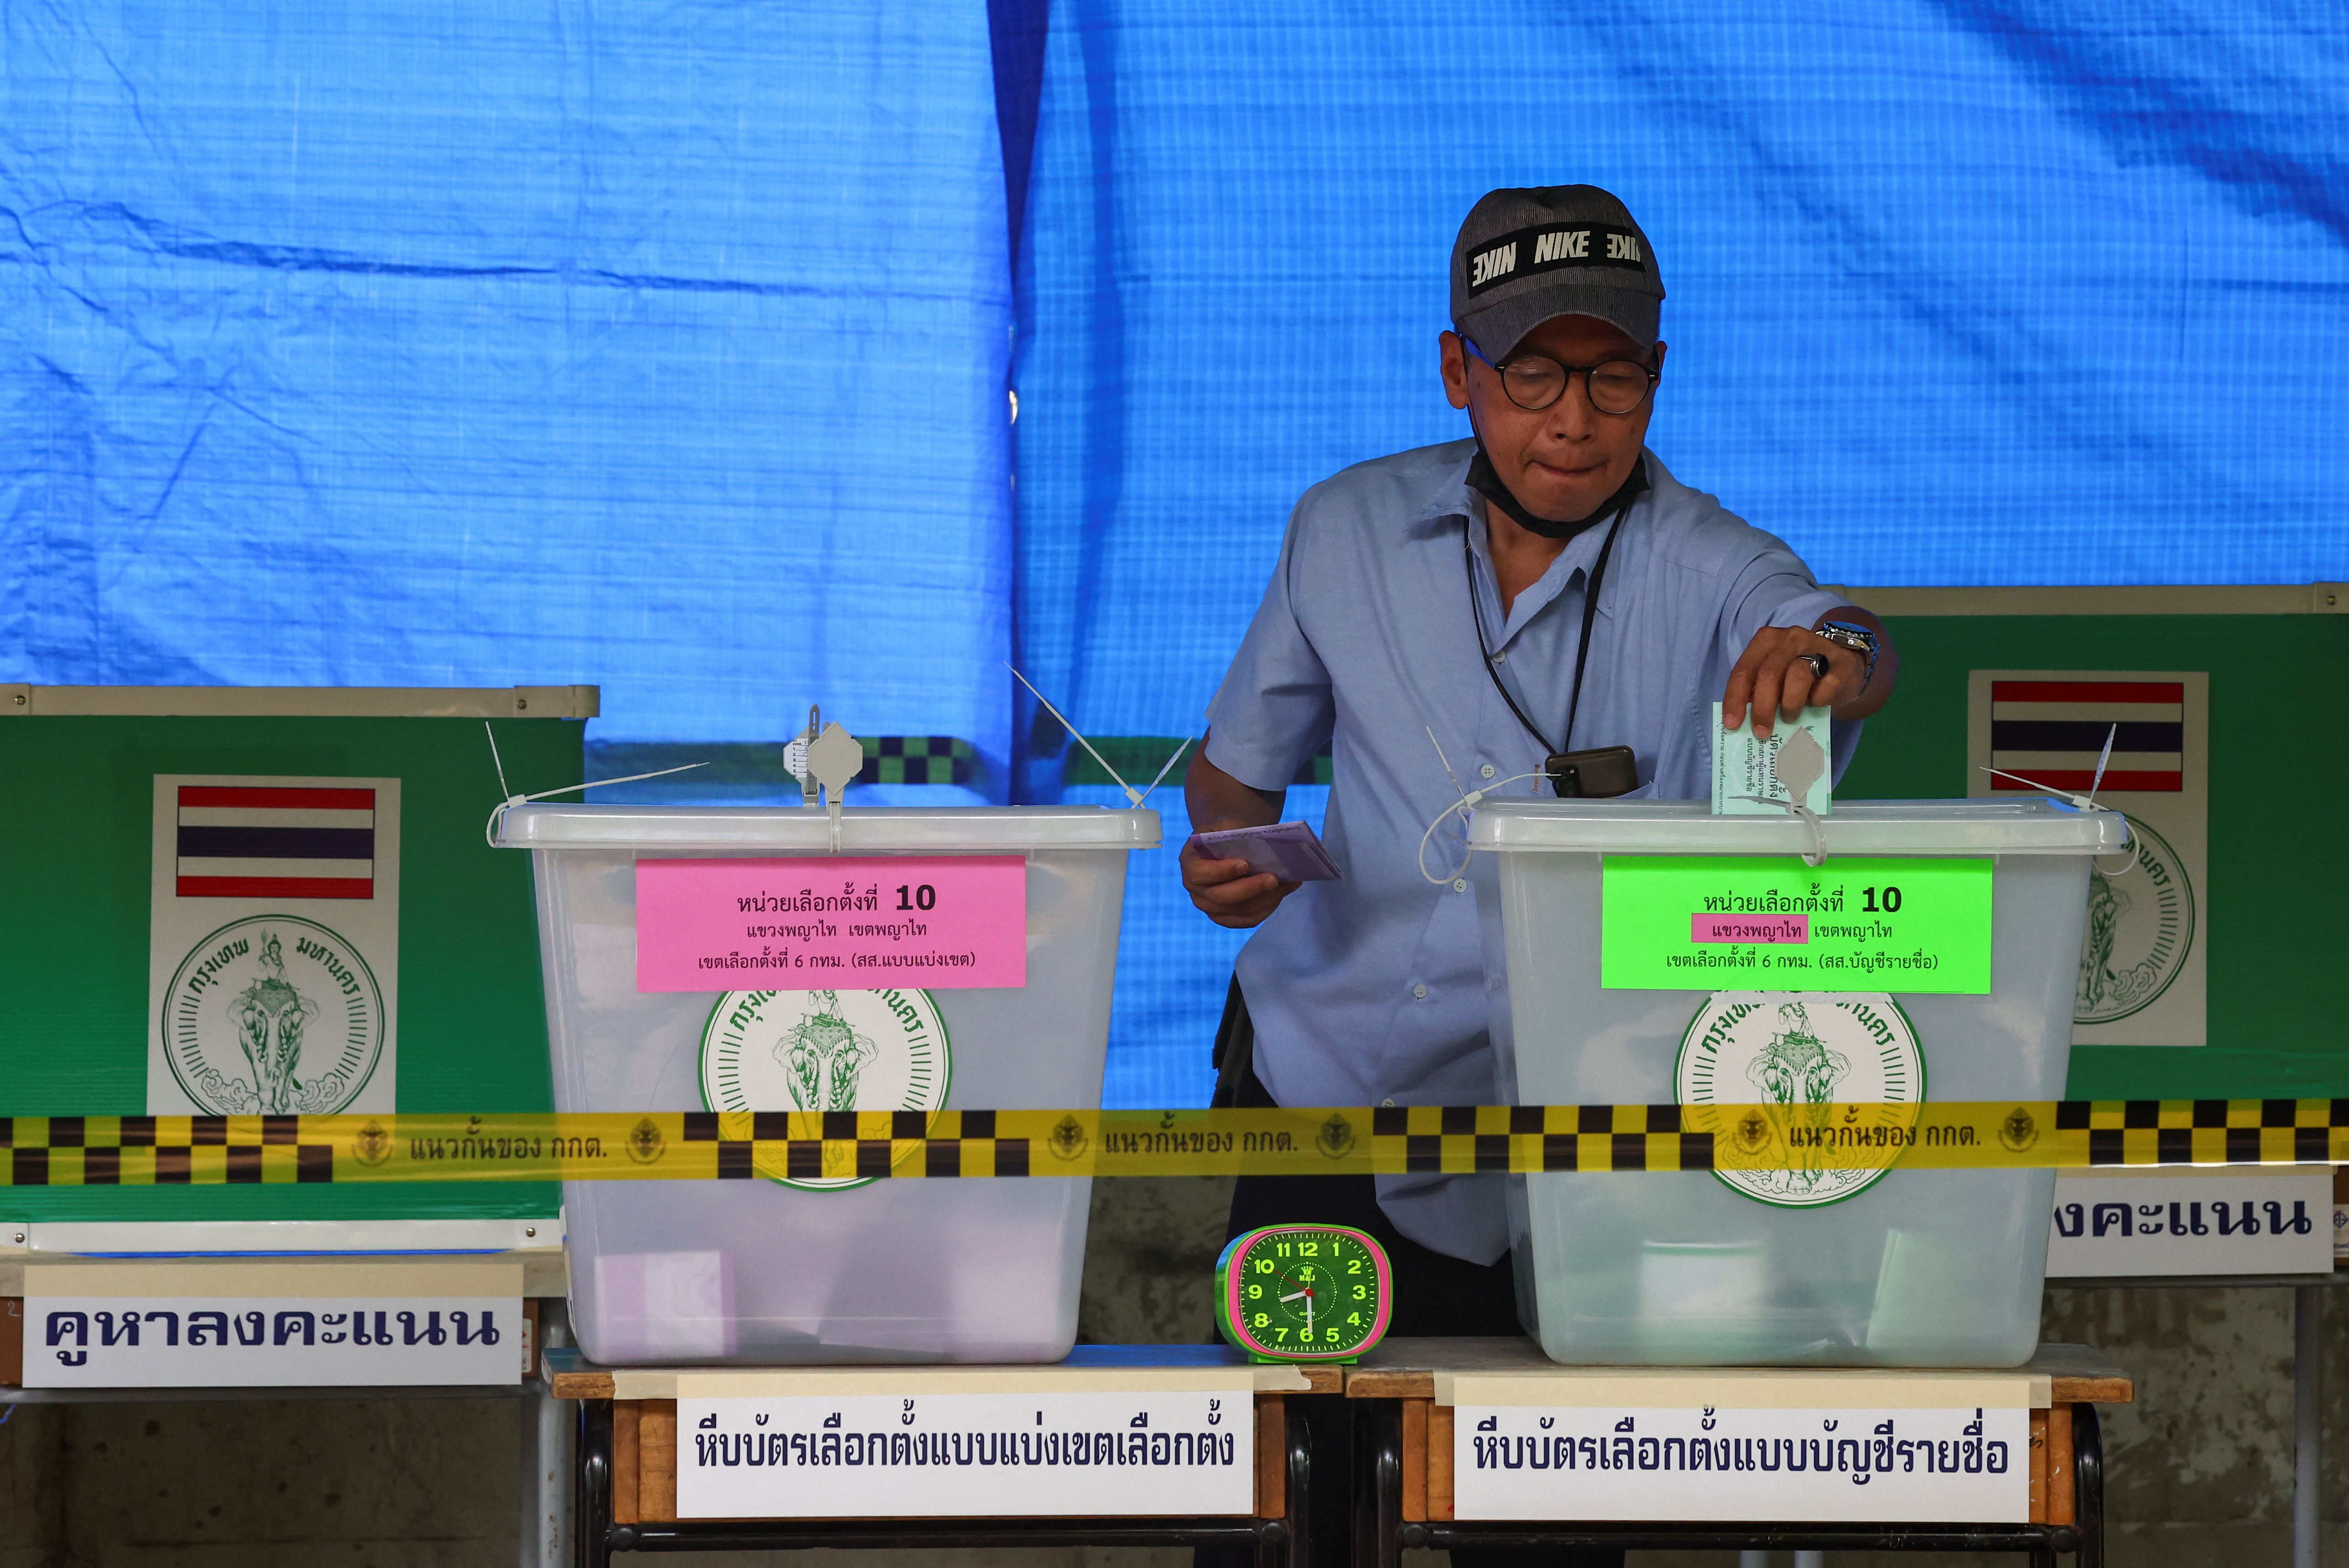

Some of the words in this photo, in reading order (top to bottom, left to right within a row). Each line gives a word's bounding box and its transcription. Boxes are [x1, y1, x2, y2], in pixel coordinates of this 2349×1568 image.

[1534, 231, 1590, 264] NIKE
[737, 882, 877, 912] หน่วยเลือกตั้งที่
[896, 884, 936, 911] 10
[1704, 882, 1843, 912] หน่วยเลือกตั้งที่
[1862, 887, 1902, 913] 10
[747, 919, 837, 941] แขวงพญาไท
[849, 918, 926, 941] เขตพญาไท
[1713, 920, 1801, 939] แขวงพญาไท
[1815, 920, 1892, 943] เขตพญาไท
[188, 938, 249, 994] กรุงเทพ
[296, 936, 361, 995] มหานคร
[698, 946, 788, 970] เขตเลือกตั้งที่
[795, 954, 803, 968] 6
[809, 955, 845, 968] กทม.
[852, 950, 975, 968] (สส.แบบแบ่งเขต)
[1667, 945, 1755, 968] เขตเลือกตั้งที่
[1762, 955, 1771, 968] 6
[1777, 956, 1812, 968] กทม.
[1819, 950, 1938, 973] (สส.บัญชีรายชื่อ)
[411, 1115, 541, 1159] แนวกั้นของ
[551, 1135, 607, 1159] กกต.
[1105, 1111, 1232, 1153] แนวกั้นของ
[1242, 1131, 1298, 1152] กกต.
[1790, 1105, 1915, 1147] แนวกั้นของ
[1926, 1125, 1981, 1146] กกต.
[1277, 1243, 1290, 1257] 11
[1298, 1242, 1318, 1257] 12
[1333, 1242, 1339, 1257] 1
[1254, 1259, 1274, 1274] 10
[1347, 1260, 1361, 1274] 2
[1248, 1284, 1262, 1300] 9
[1352, 1285, 1366, 1300] 3
[1254, 1313, 1268, 1328] 8
[1347, 1312, 1361, 1326] 4
[46, 1311, 500, 1367] คูหาลงคะแนน
[1275, 1328, 1288, 1342] 7
[1299, 1328, 1314, 1342] 6
[1325, 1328, 1340, 1342] 5
[695, 1398, 1234, 1466] หีบบัตรเลือกตั้งแบบแบ่งเขตเลือกตั้ง
[1473, 1404, 2008, 1485] หีบบัตรเลือกตั้งแบบบัญชีรายชื่อ
